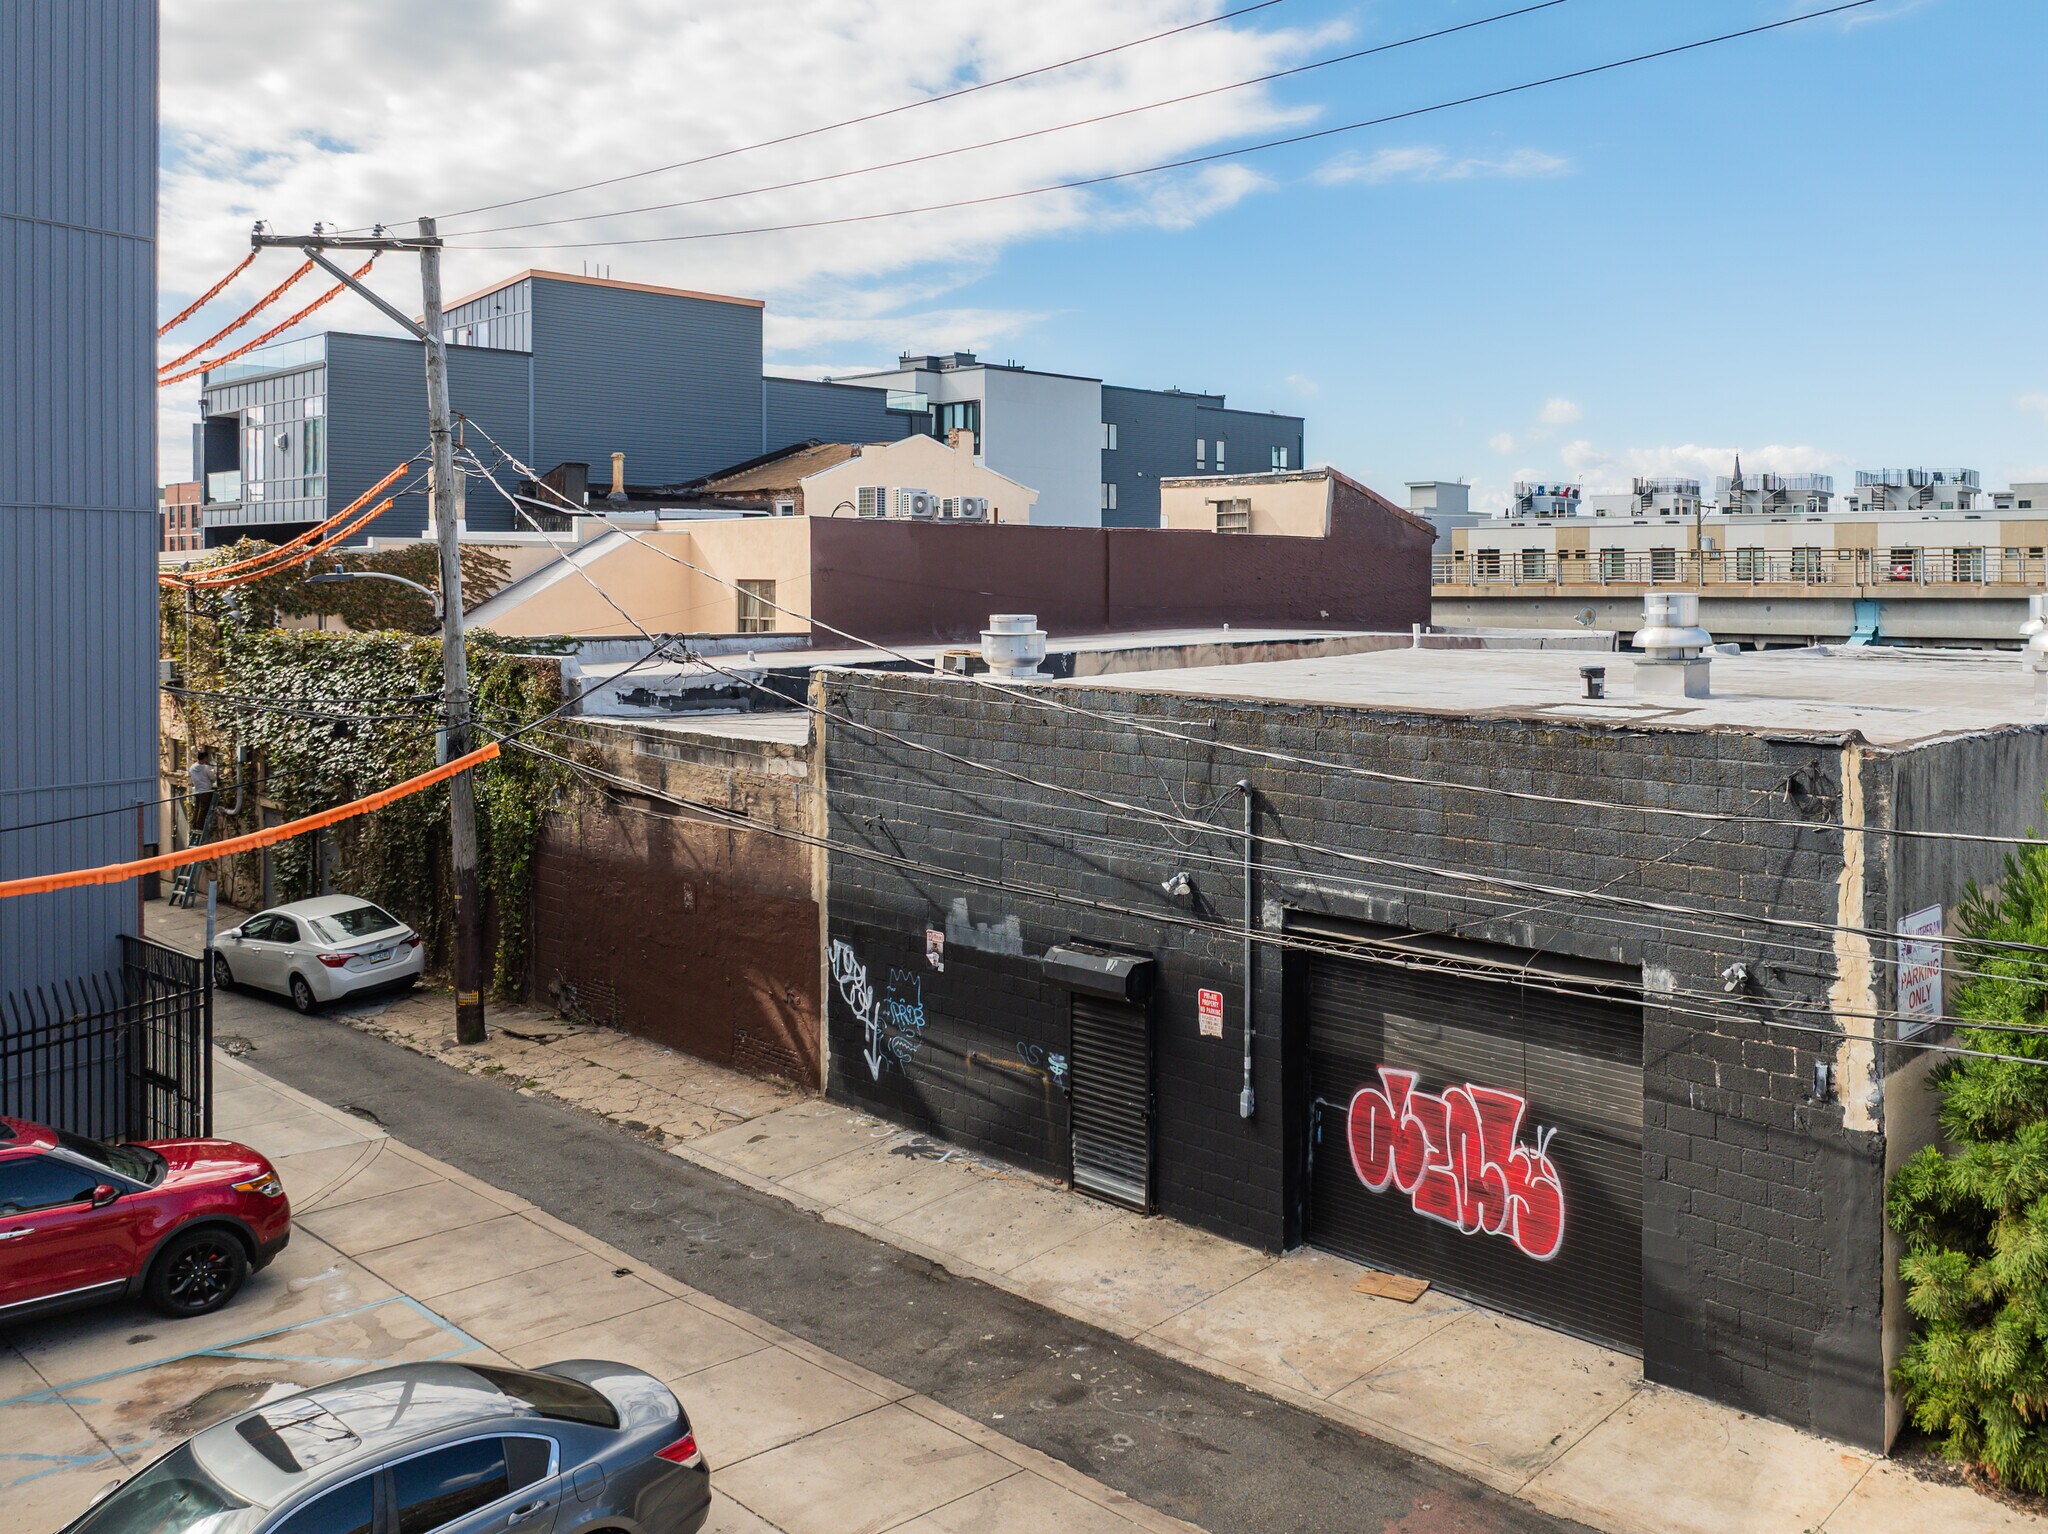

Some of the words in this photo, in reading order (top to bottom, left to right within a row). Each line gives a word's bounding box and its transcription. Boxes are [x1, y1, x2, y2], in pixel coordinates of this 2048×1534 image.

[1901, 958, 1939, 990] PARKING
[1202, 999, 1218, 1008] PROPERTY
[1909, 983, 1932, 1009] ONLY
[1206, 1007, 1221, 1016] PARKING
